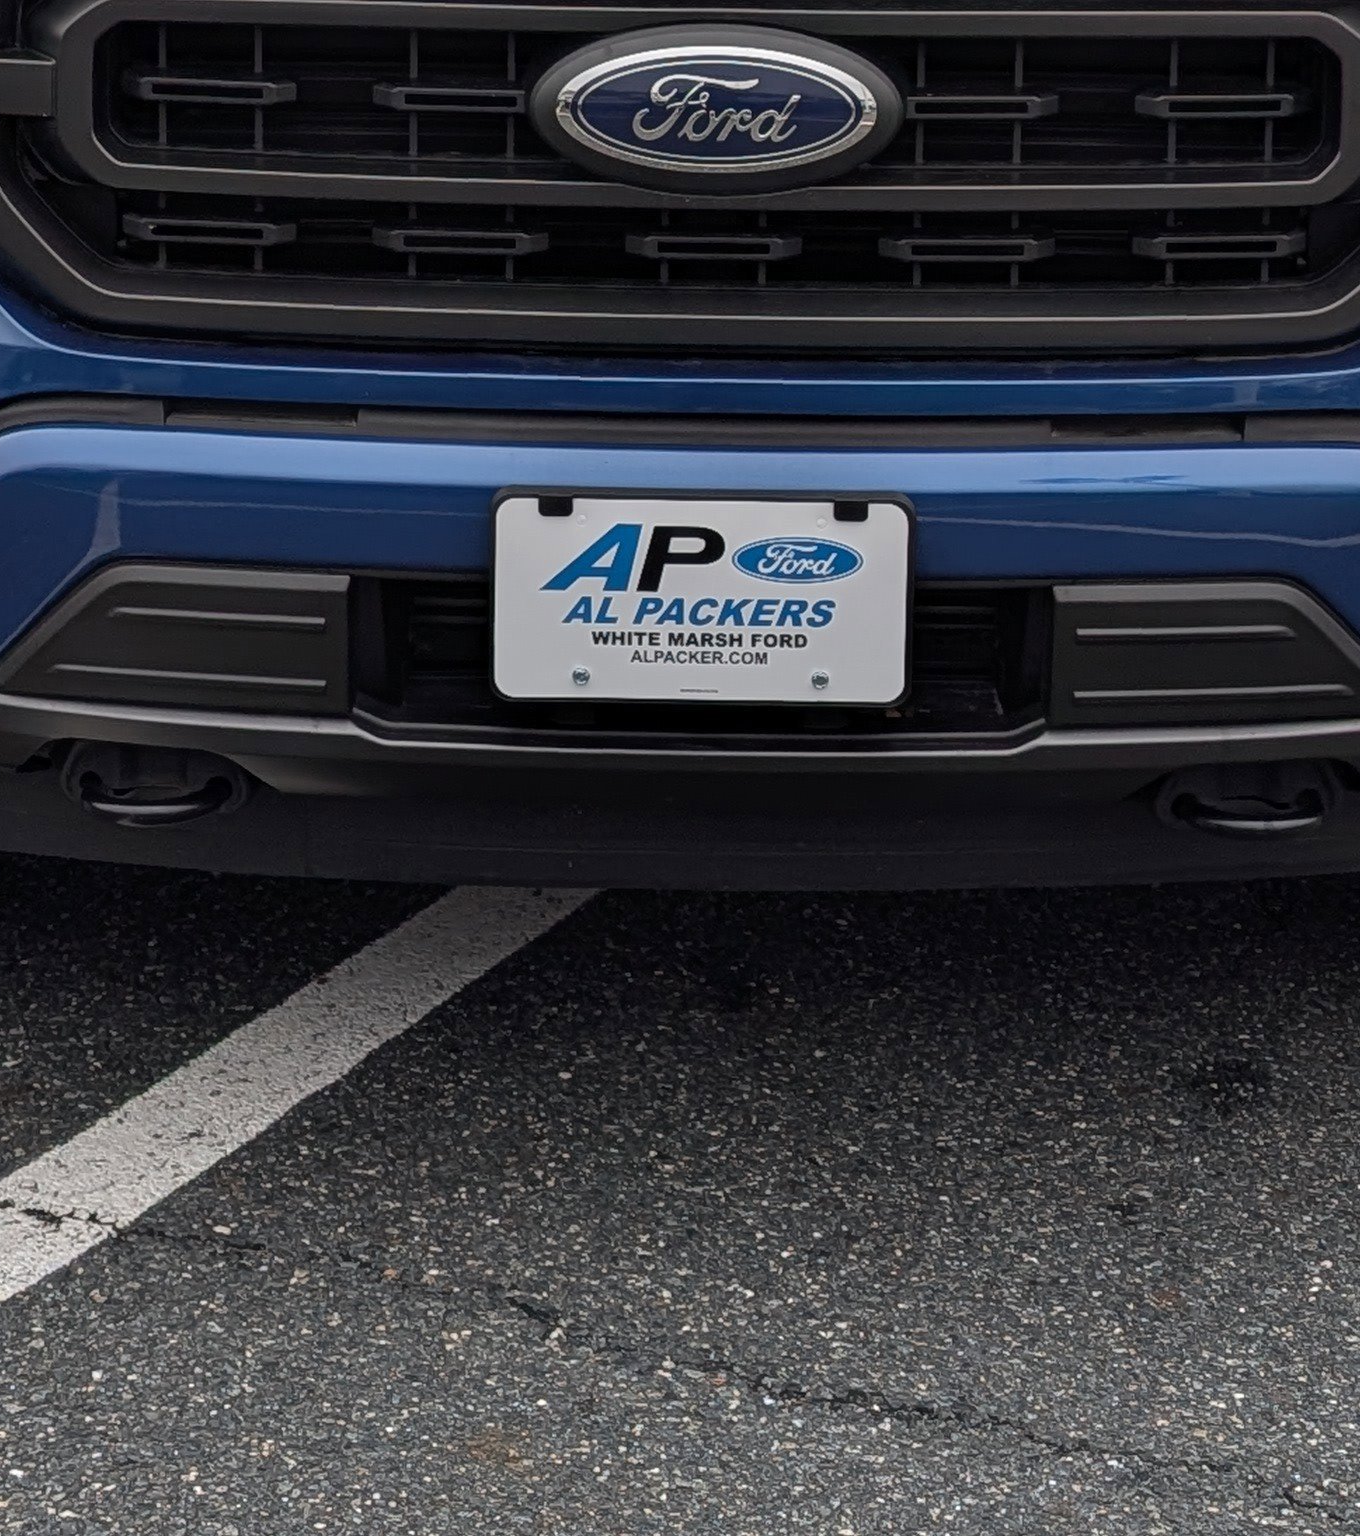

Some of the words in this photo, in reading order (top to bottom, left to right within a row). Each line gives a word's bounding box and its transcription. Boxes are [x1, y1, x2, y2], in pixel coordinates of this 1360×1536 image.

[632, 73, 802, 143] Ford
[540, 522, 726, 592] AP
[757, 543, 836, 577] Ford
[562, 596, 617, 624] AL
[633, 598, 836, 628] PACKERS
[591, 631, 661, 647] WHITE
[668, 632, 743, 648] MARSH
[750, 634, 808, 650] FORD
[630, 650, 768, 665] ALPACKER.COM
